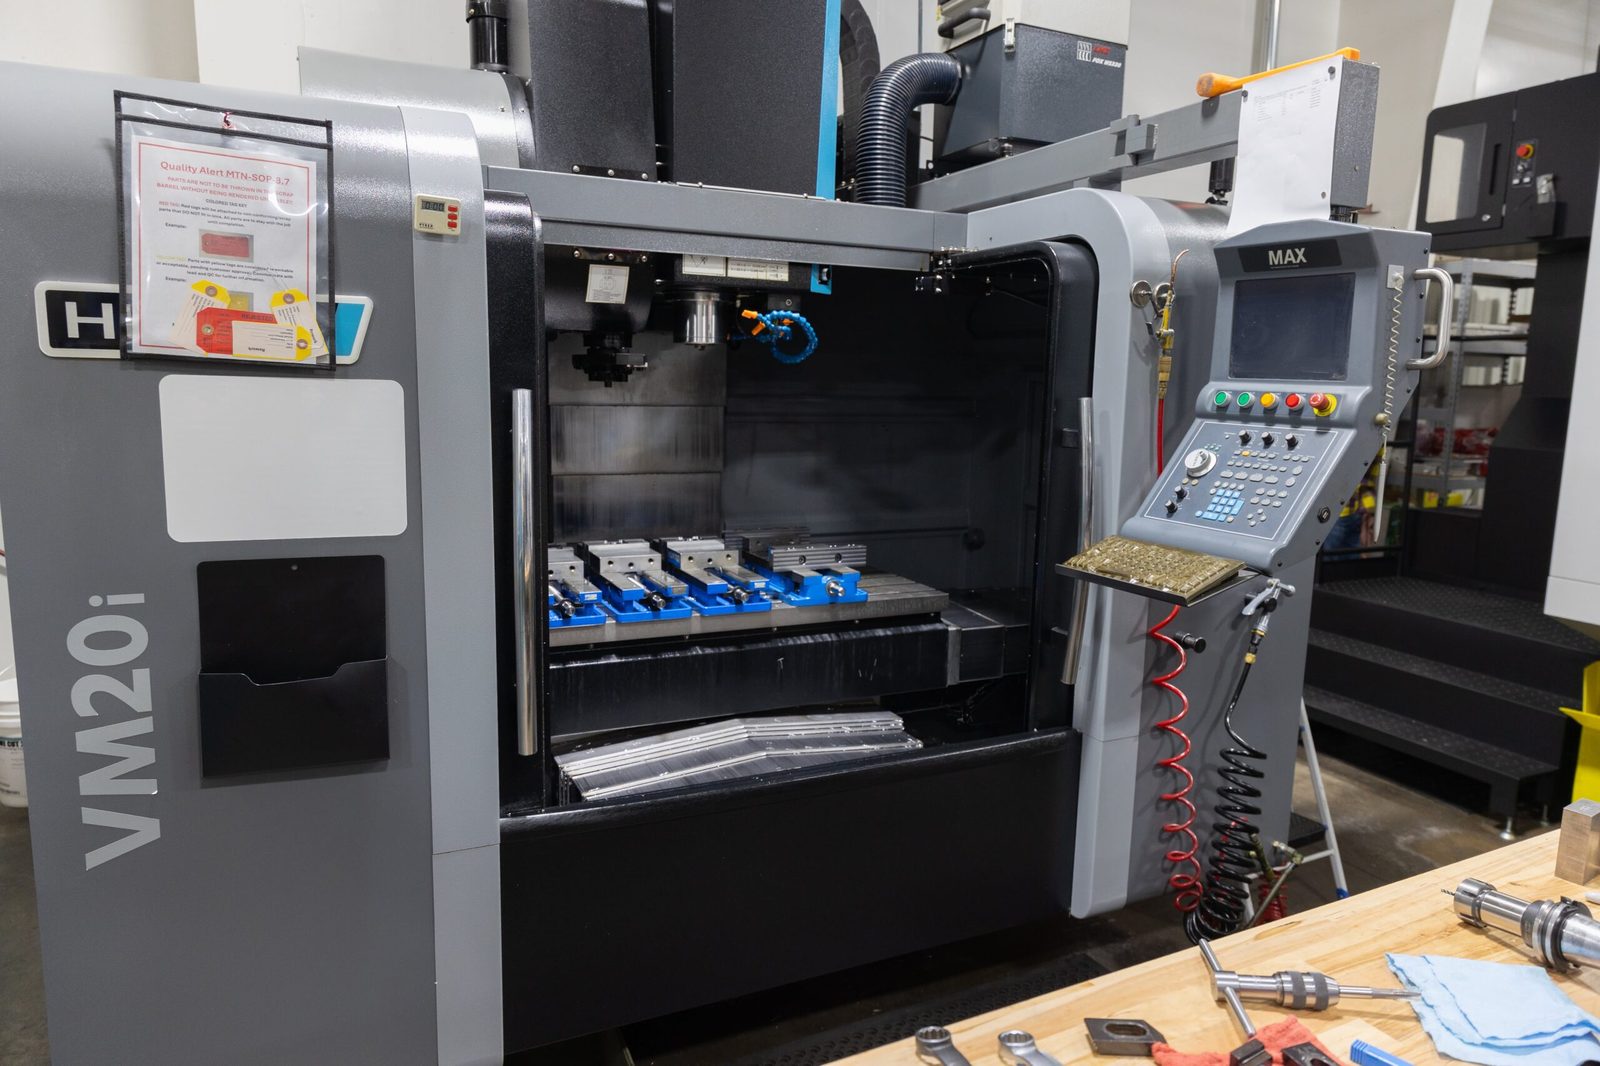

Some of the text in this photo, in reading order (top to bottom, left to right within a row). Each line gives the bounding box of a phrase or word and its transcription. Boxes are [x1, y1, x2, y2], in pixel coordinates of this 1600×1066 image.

[160, 161, 197, 174] Quality
[199, 167, 224, 177] Alert
[157, 182, 180, 190] BARREL
[180, 186, 208, 194] WITHOUT
[228, 193, 259, 201] RENDERED
[230, 185, 255, 193] THROWN
[205, 198, 228, 206] COLORED
[1268, 247, 1307, 266] MAX
[66, 593, 161, 870] VM20i
